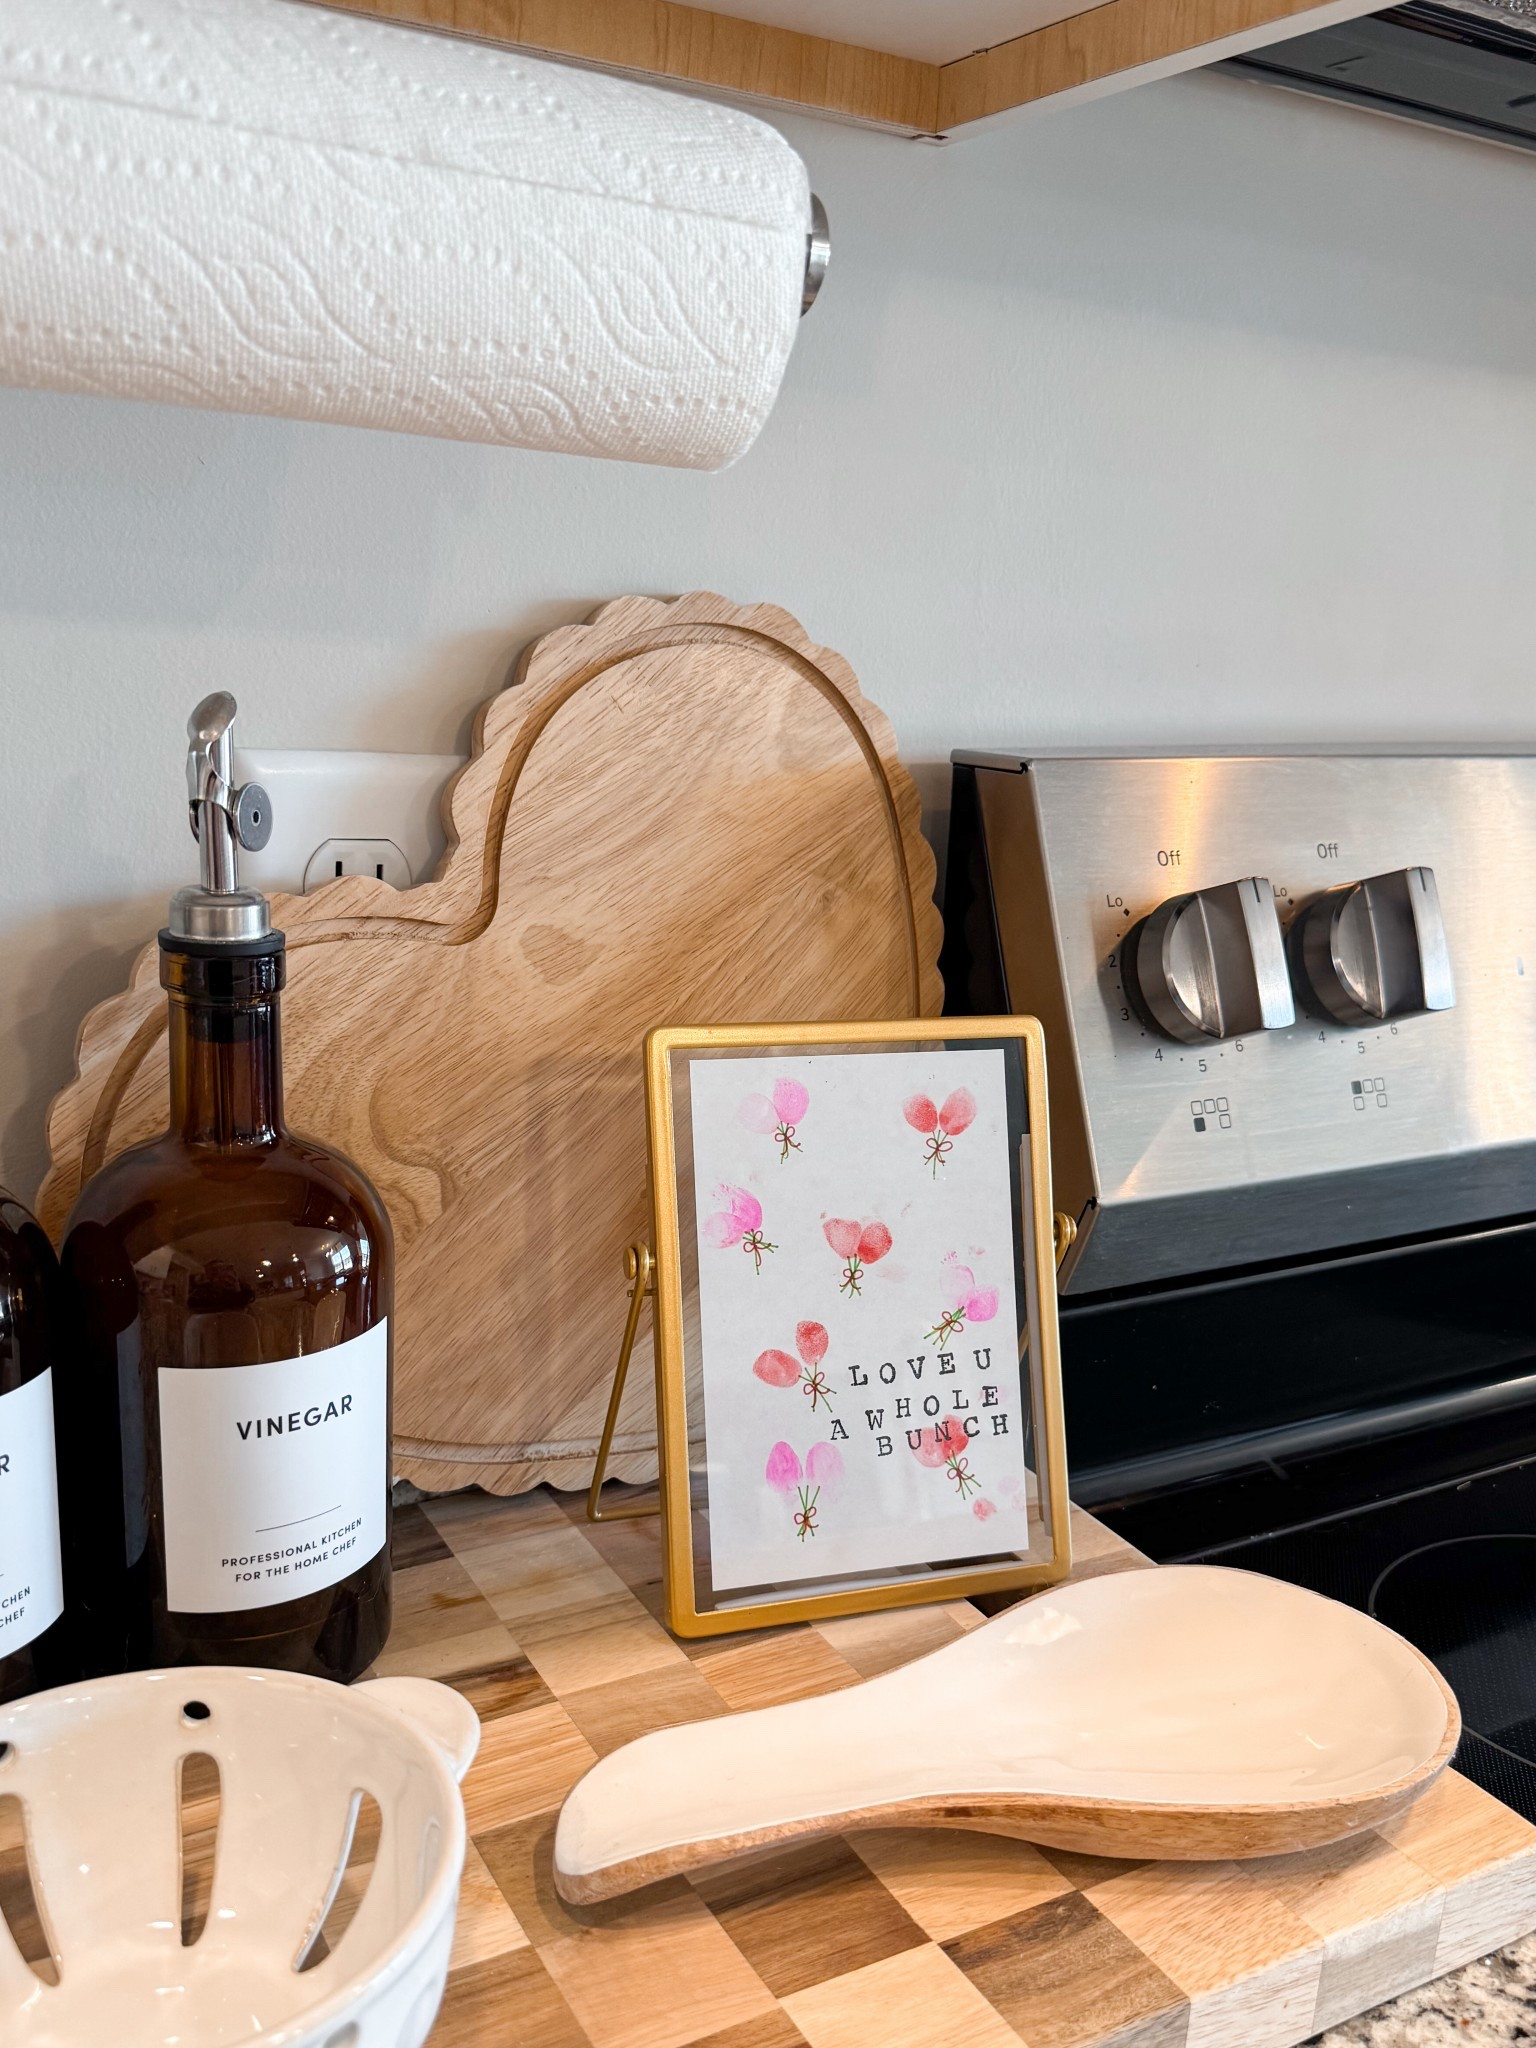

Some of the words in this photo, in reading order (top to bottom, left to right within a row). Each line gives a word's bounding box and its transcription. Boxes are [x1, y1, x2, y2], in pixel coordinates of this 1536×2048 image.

[1156, 850, 1181, 866] Off
[1316, 843, 1339, 859] Off
[1273, 884, 1288, 898] Lo
[1106, 894, 1123, 908] Lo
[1108, 954, 1117, 968] 2
[1121, 1007, 1130, 1021] 3
[1390, 1022, 1398, 1036] 6
[1318, 1030, 1326, 1044] 4
[1235, 1039, 1244, 1053] 6
[1358, 1041, 1366, 1055] 5
[1155, 1048, 1164, 1062] 4
[1198, 1059, 1207, 1073] 5
[848, 1352, 956, 1387] LOVE
[973, 1348, 991, 1370] U
[236, 1394, 353, 1440] VINEGAR
[830, 1418, 850, 1441] A
[865, 1385, 999, 1431] WHOLE
[876, 1413, 1009, 1457] BUNCH
[221, 1540, 318, 1567] PROFESSIONAL
[321, 1517, 362, 1545] KITCHEN
[235, 1571, 261, 1583] FOR
[265, 1564, 290, 1578] THE
[294, 1551, 329, 1571] HOME
[332, 1536, 357, 1556] CHEF
[0, 1606, 25, 1628] CHEF
